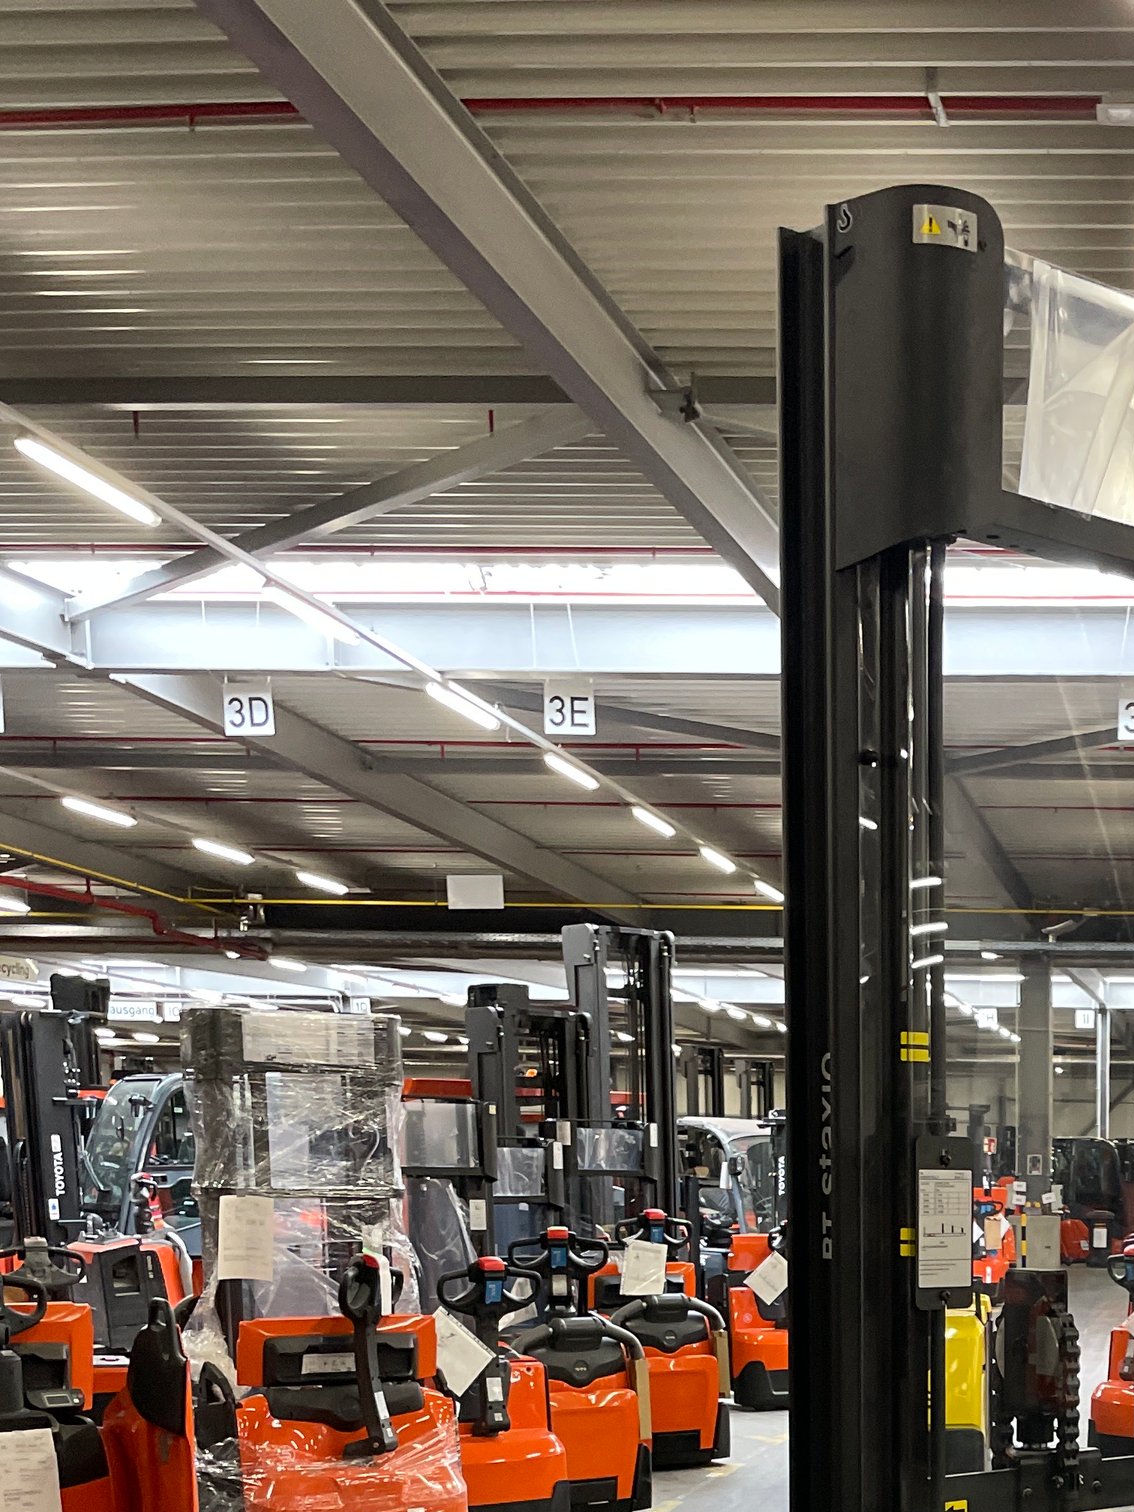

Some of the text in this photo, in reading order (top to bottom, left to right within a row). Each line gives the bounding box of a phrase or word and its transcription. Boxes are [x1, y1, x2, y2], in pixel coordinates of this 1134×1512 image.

[229, 696, 269, 728] 3D
[549, 695, 589, 728] 3E
[0, 962, 30, 979] cycling
[53, 1152, 66, 1197] TOYOTA
[778, 1155, 786, 1196] TOYOTA
